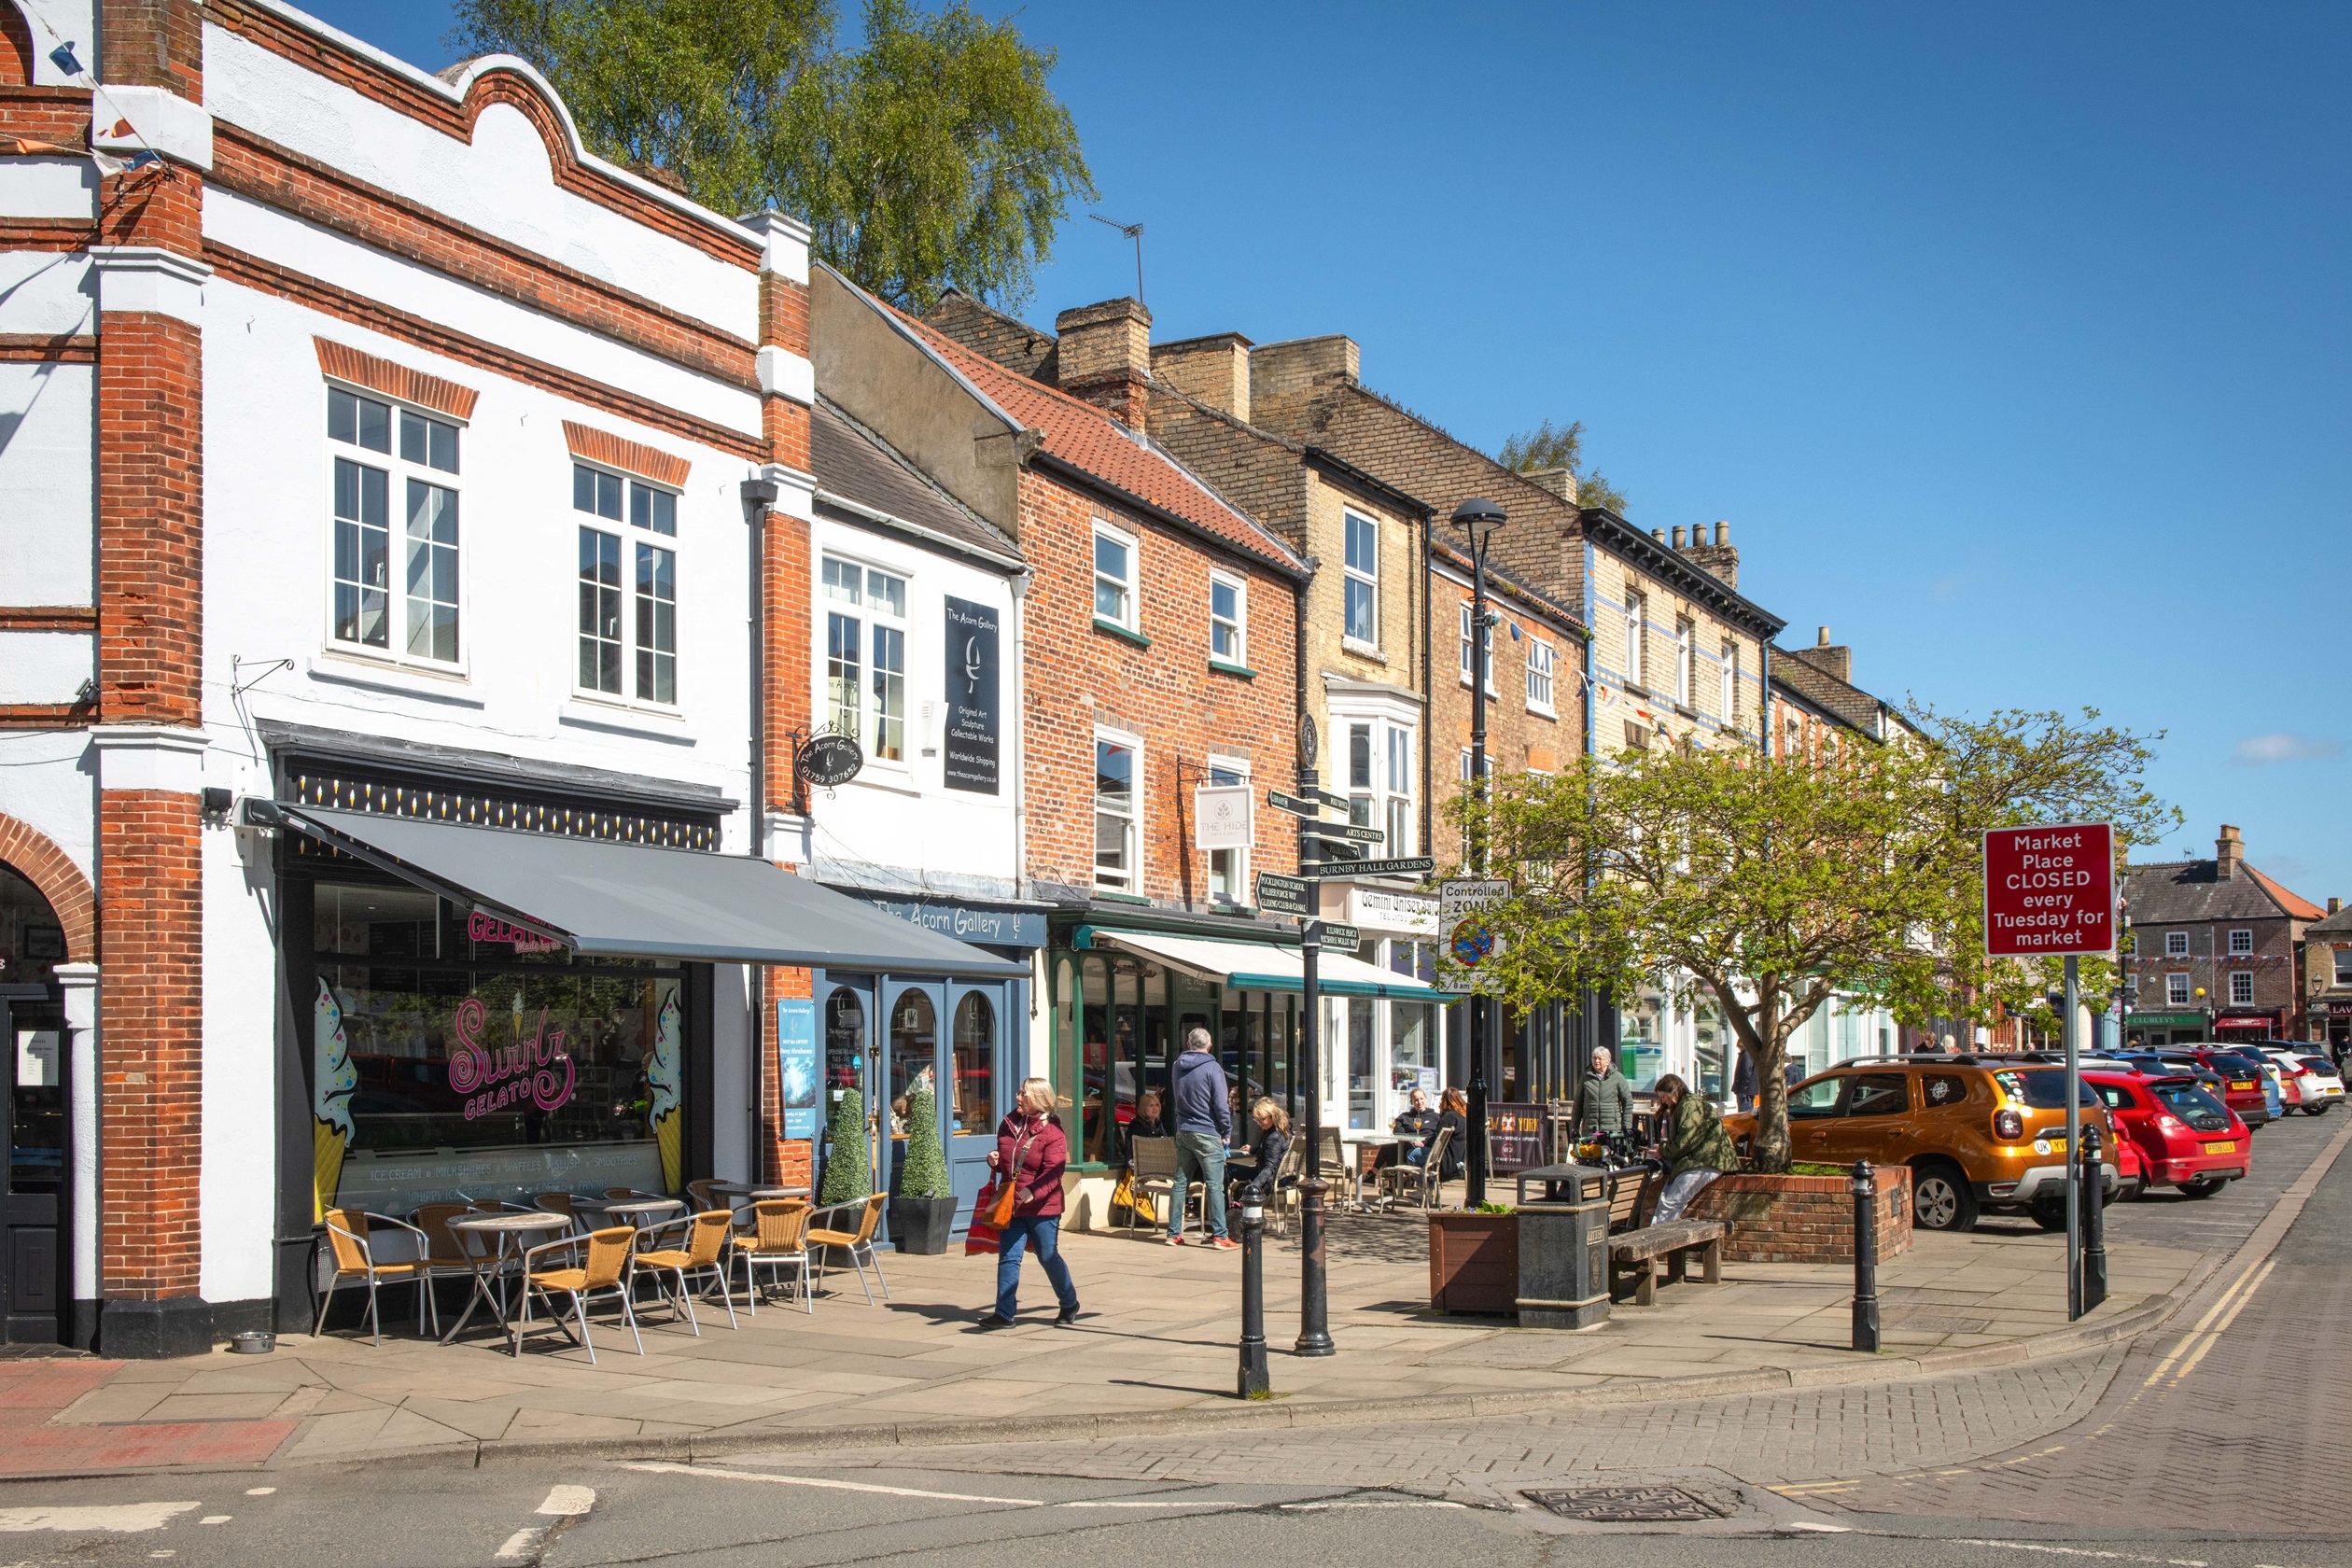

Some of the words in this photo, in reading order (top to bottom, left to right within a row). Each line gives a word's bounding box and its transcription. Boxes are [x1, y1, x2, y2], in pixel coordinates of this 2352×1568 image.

[946, 608, 959, 621] The
[960, 612, 977, 625] Acorn
[978, 616, 997, 633] Gallery
[958, 706, 977, 718] Original
[978, 710, 987, 719] Art
[961, 719, 984, 730] Sculpture
[951, 729, 977, 741] Collectable
[978, 734, 993, 744] Works
[801, 750, 813, 763] The
[815, 742, 835, 754] Acorn
[837, 739, 859, 760] Gallery
[949, 750, 974, 763] Worldwide
[976, 756, 996, 768] Shipping
[803, 766, 825, 782] 01759
[829, 763, 858, 783] 307652
[1200, 822, 1219, 831] THE
[1225, 821, 1247, 830] HIDE
[1346, 829, 1360, 837] ARTS
[1361, 831, 1382, 840] CENTRE
[2014, 833, 2081, 851] Market
[1320, 864, 1356, 875] BURNBY
[1359, 862, 1384, 873] HALL
[1387, 859, 1431, 870] GARDENS
[2023, 854, 2073, 870] Place
[1261, 876, 1288, 889] POCKLINGTON
[1290, 881, 1305, 891] SCHOOL
[2006, 870, 2091, 889] CLOSED
[1447, 887, 1505, 896] Controlled
[1293, 903, 1306, 912] CANAL
[1363, 889, 1391, 910] Gemini
[1393, 893, 1420, 913] Unisex
[1421, 898, 1440, 917] Salo
[2023, 894, 2073, 909] every
[910, 903, 950, 930] Acorn
[955, 907, 1001, 939] Gallery
[1379, 912, 1390, 920] TEL
[1994, 911, 2069, 928] Tuesday
[2076, 909, 2104, 924] for
[516, 941, 538, 951] Made
[541, 940, 550, 950] by
[1320, 935, 1337, 944] RKSHIRE
[2016, 929, 2082, 946] market
[465, 1077, 532, 1120] GELATO
[1488, 1117, 1499, 1130] EW
[1519, 1118, 1539, 1131] YORK
[2037, 1142, 2050, 1152] UK
[371, 1170, 386, 1182] ICE
[389, 1169, 420, 1180] CREAM
[436, 1165, 491, 1178] MILKSHAKES
[505, 1161, 541, 1171] WAFFLES
[554, 1158, 580, 1169] SLUSH
[593, 1155, 637, 1166] SMOOTHIES
[409, 1190, 442, 1202] WHIPPY
[445, 1189, 459, 1200] ICE
[463, 1187, 492, 1198] CREAM
[536, 1181, 567, 1192] COFFEE
